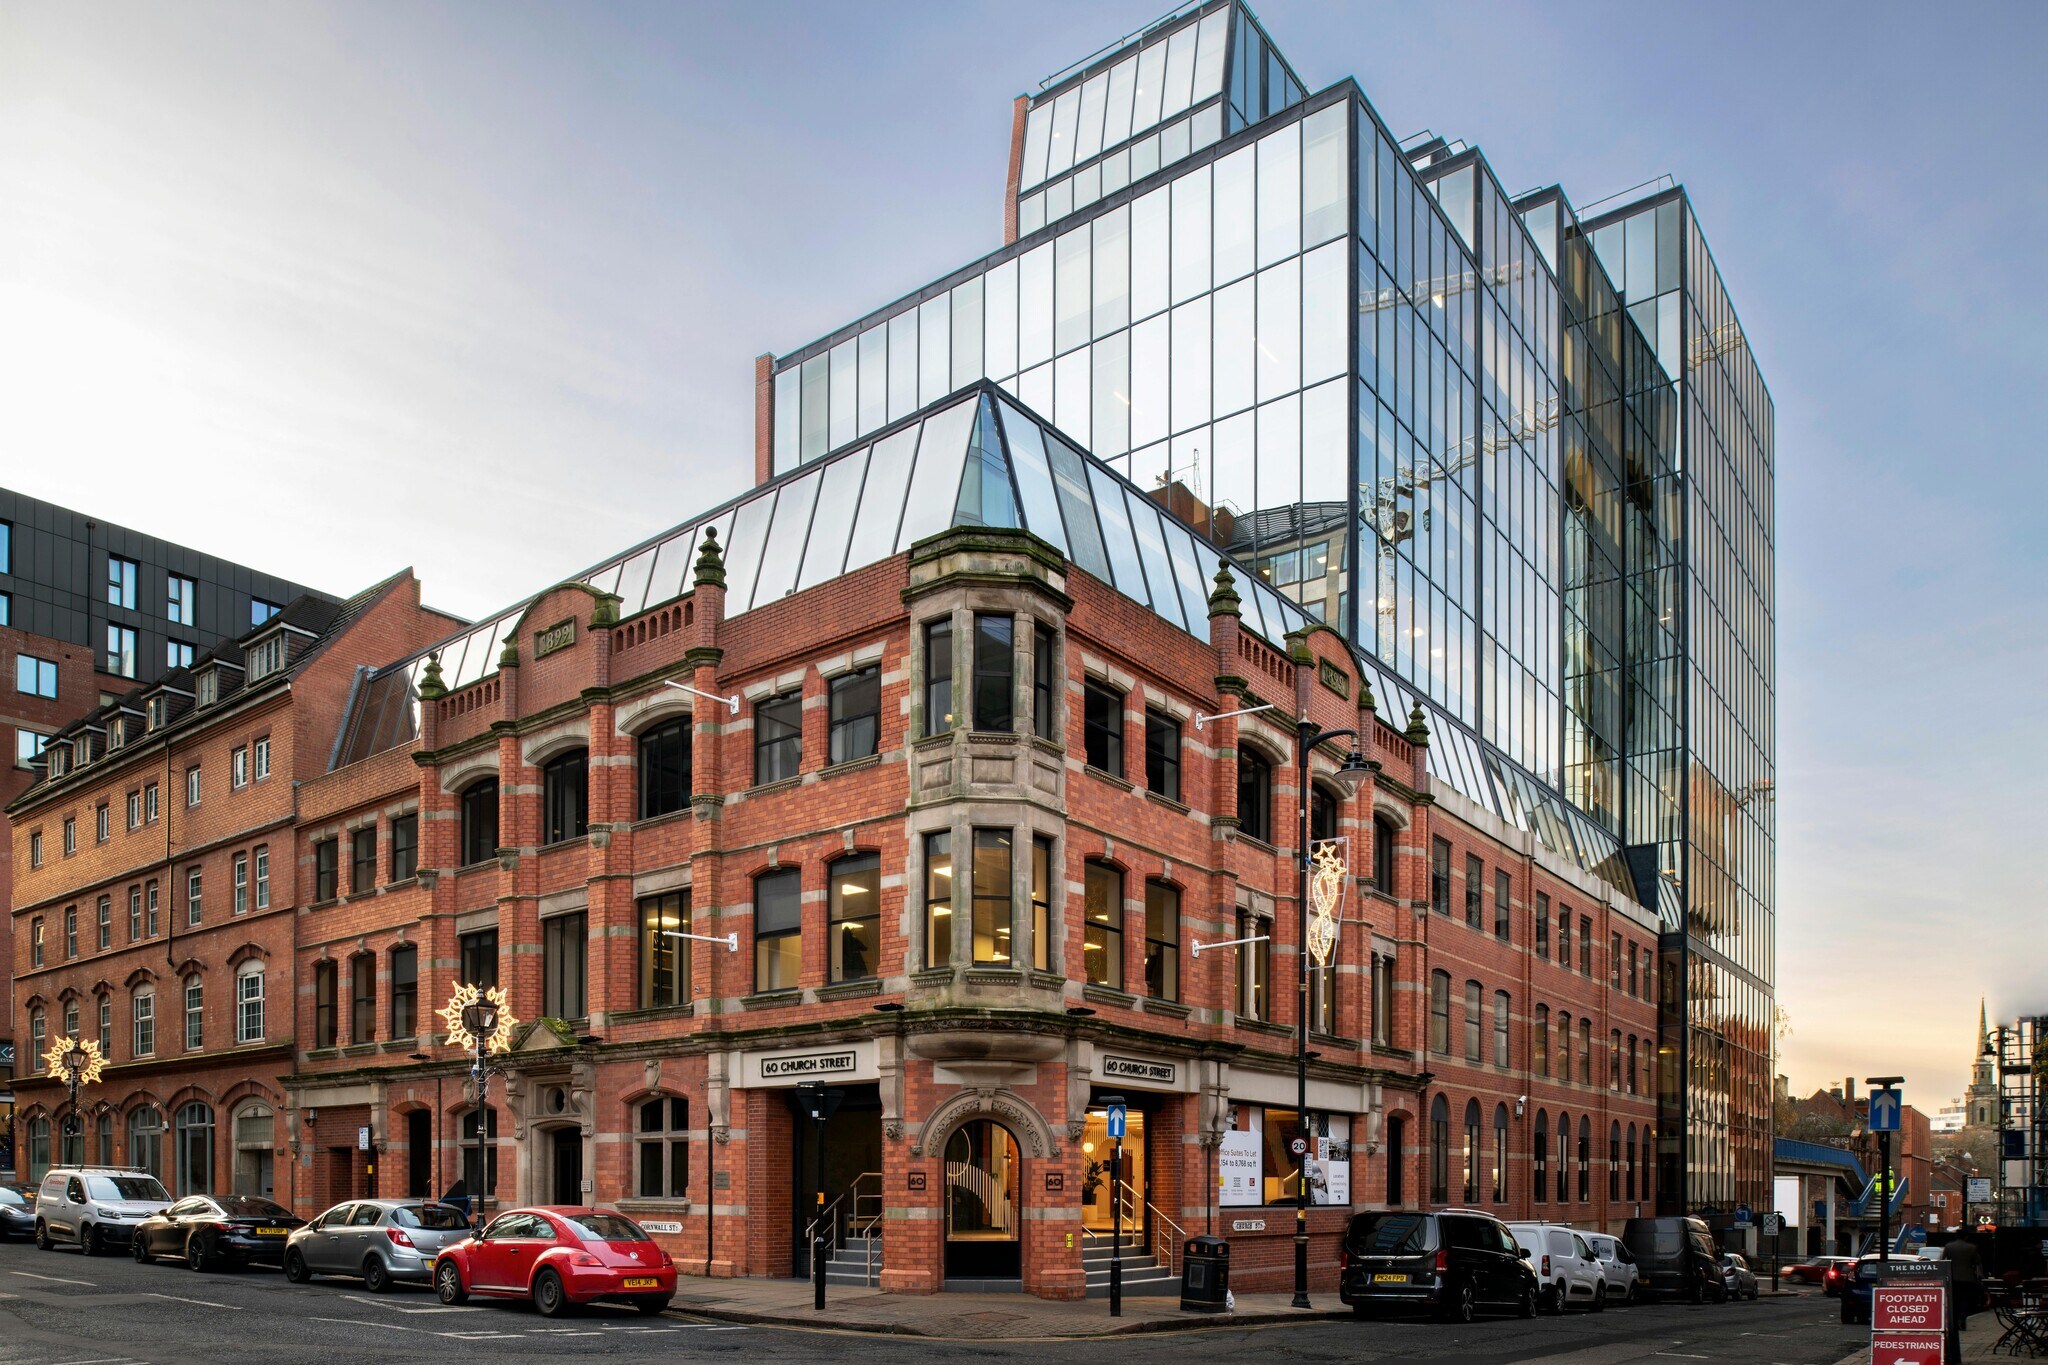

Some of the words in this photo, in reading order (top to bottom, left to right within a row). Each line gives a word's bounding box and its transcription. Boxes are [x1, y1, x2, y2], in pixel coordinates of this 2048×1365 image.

[766, 1062, 778, 1073] 60
[780, 1059, 817, 1072] CHURCH
[820, 1056, 851, 1069] STREET
[1107, 1061, 1118, 1071] 60
[1119, 1062, 1148, 1075] CHURCH
[1149, 1066, 1172, 1078] STREET
[1293, 1142, 1306, 1150] 20
[1230, 1149, 1243, 1157] Suites
[910, 1177, 924, 1186] 60
[1048, 1177, 1062, 1186] 60
[1879, 1294, 1937, 1303] FOOTPATH
[1886, 1305, 1930, 1313] CLOSED
[1889, 1315, 1926, 1323] AHEAD
[1874, 1341, 1940, 1350] PEDESTRIANS
